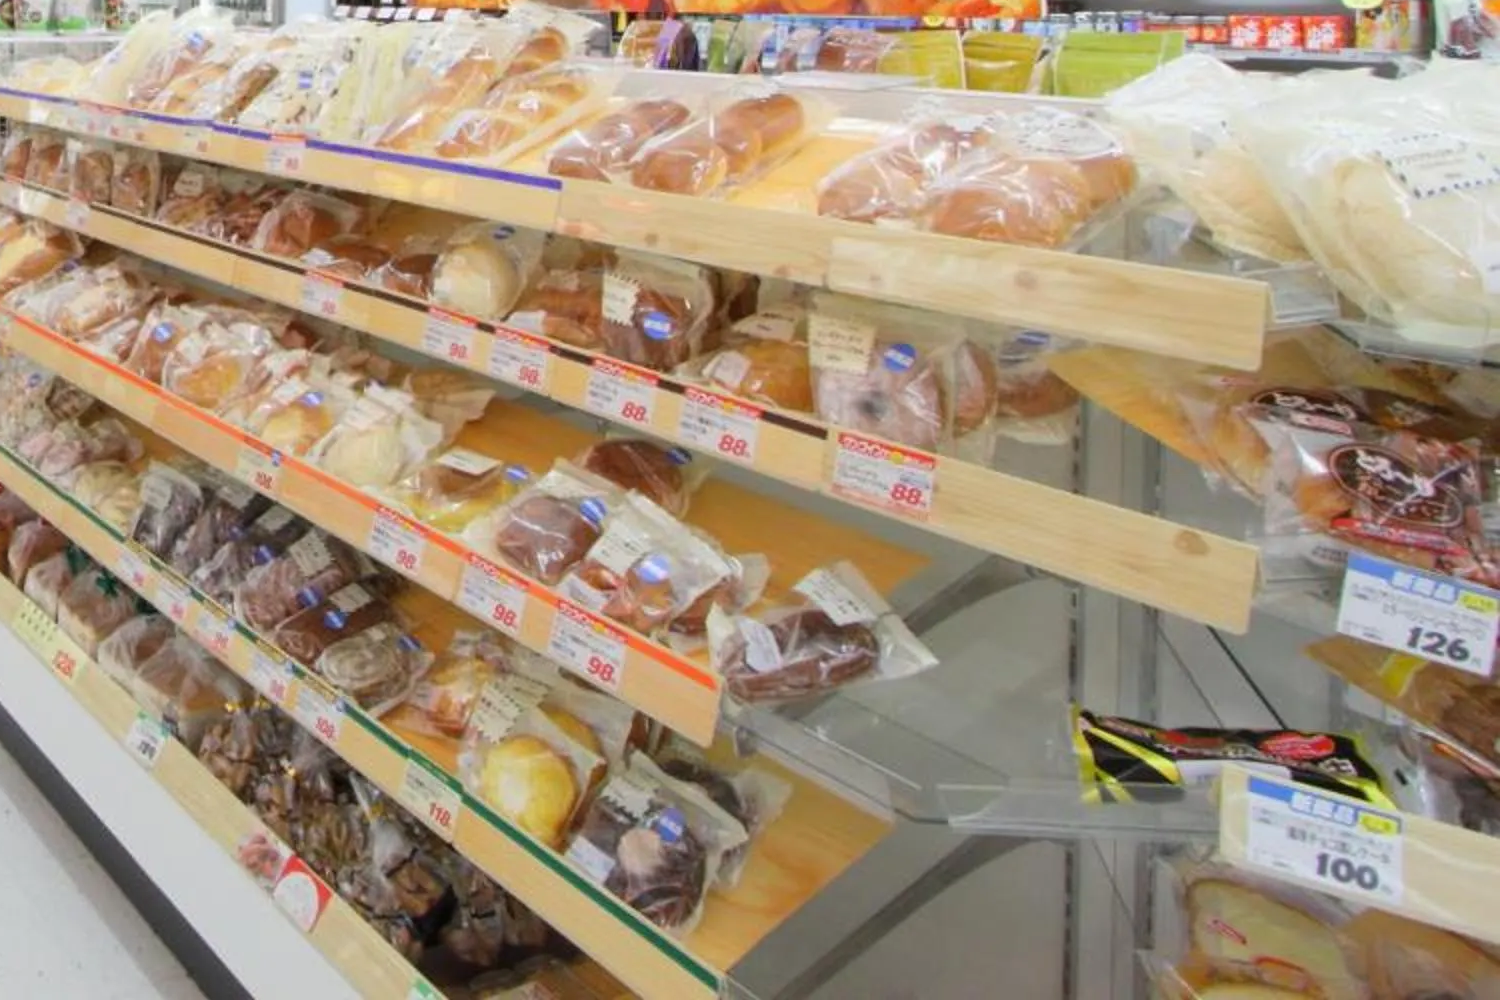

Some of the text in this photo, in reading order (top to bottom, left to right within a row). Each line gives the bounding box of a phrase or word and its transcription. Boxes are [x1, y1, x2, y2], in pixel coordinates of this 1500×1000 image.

[621, 401, 647, 422] 88
[718, 434, 748, 456] 88
[891, 483, 922, 506] 88
[492, 604, 517, 629] 98
[1407, 626, 1470, 662] 126
[587, 656, 615, 682] 98
[1316, 852, 1379, 890] 100
